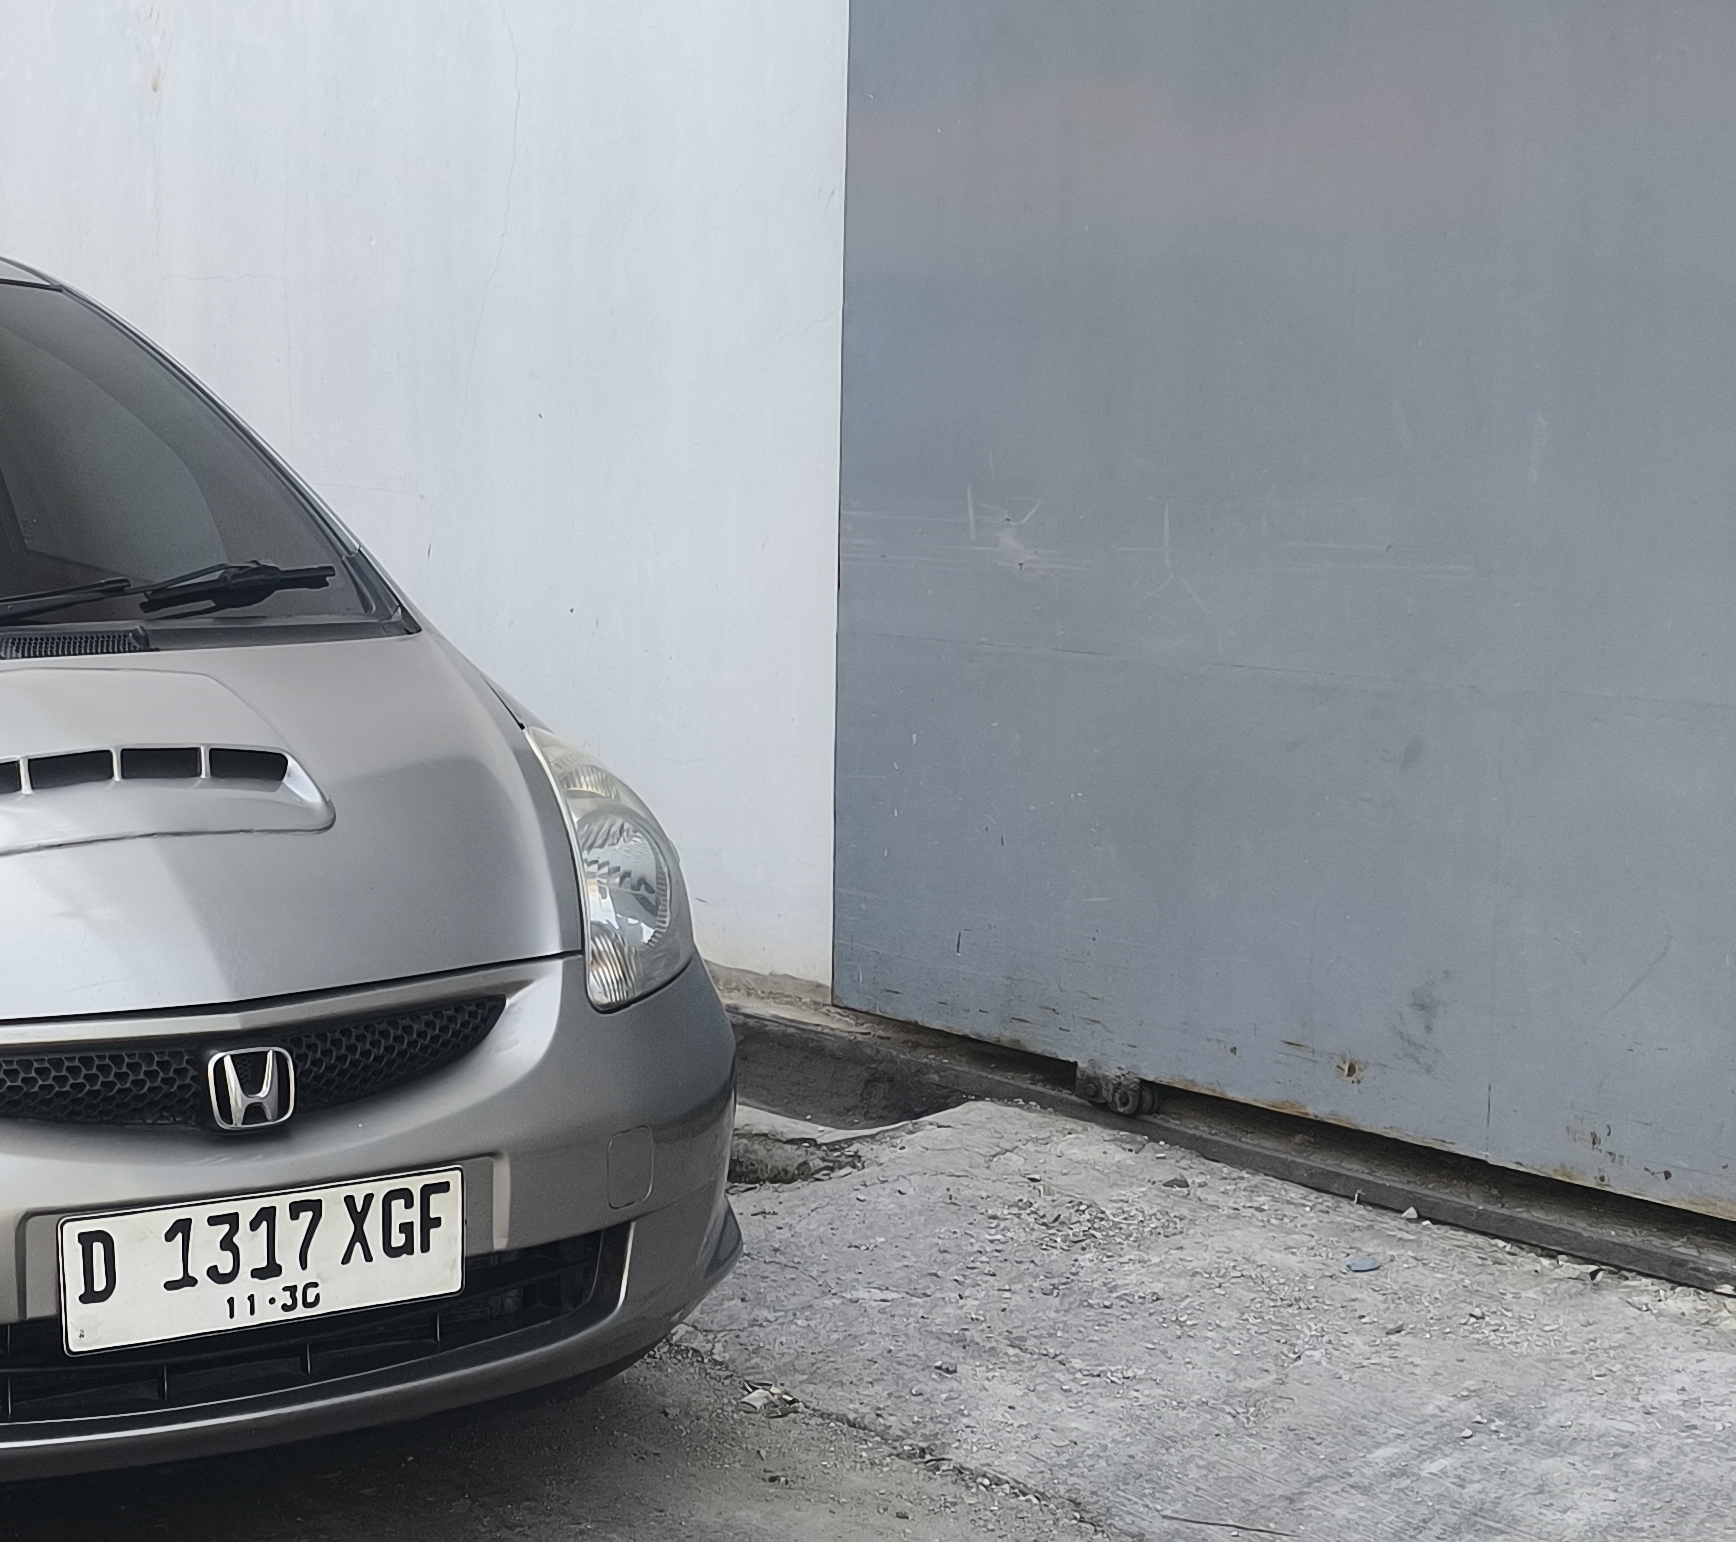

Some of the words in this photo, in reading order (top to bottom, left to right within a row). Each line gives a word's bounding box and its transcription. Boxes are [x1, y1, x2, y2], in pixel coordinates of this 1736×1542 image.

[77, 1229, 117, 1305] D
[163, 1198, 323, 1292] 1317
[340, 1180, 451, 1266] XGF
